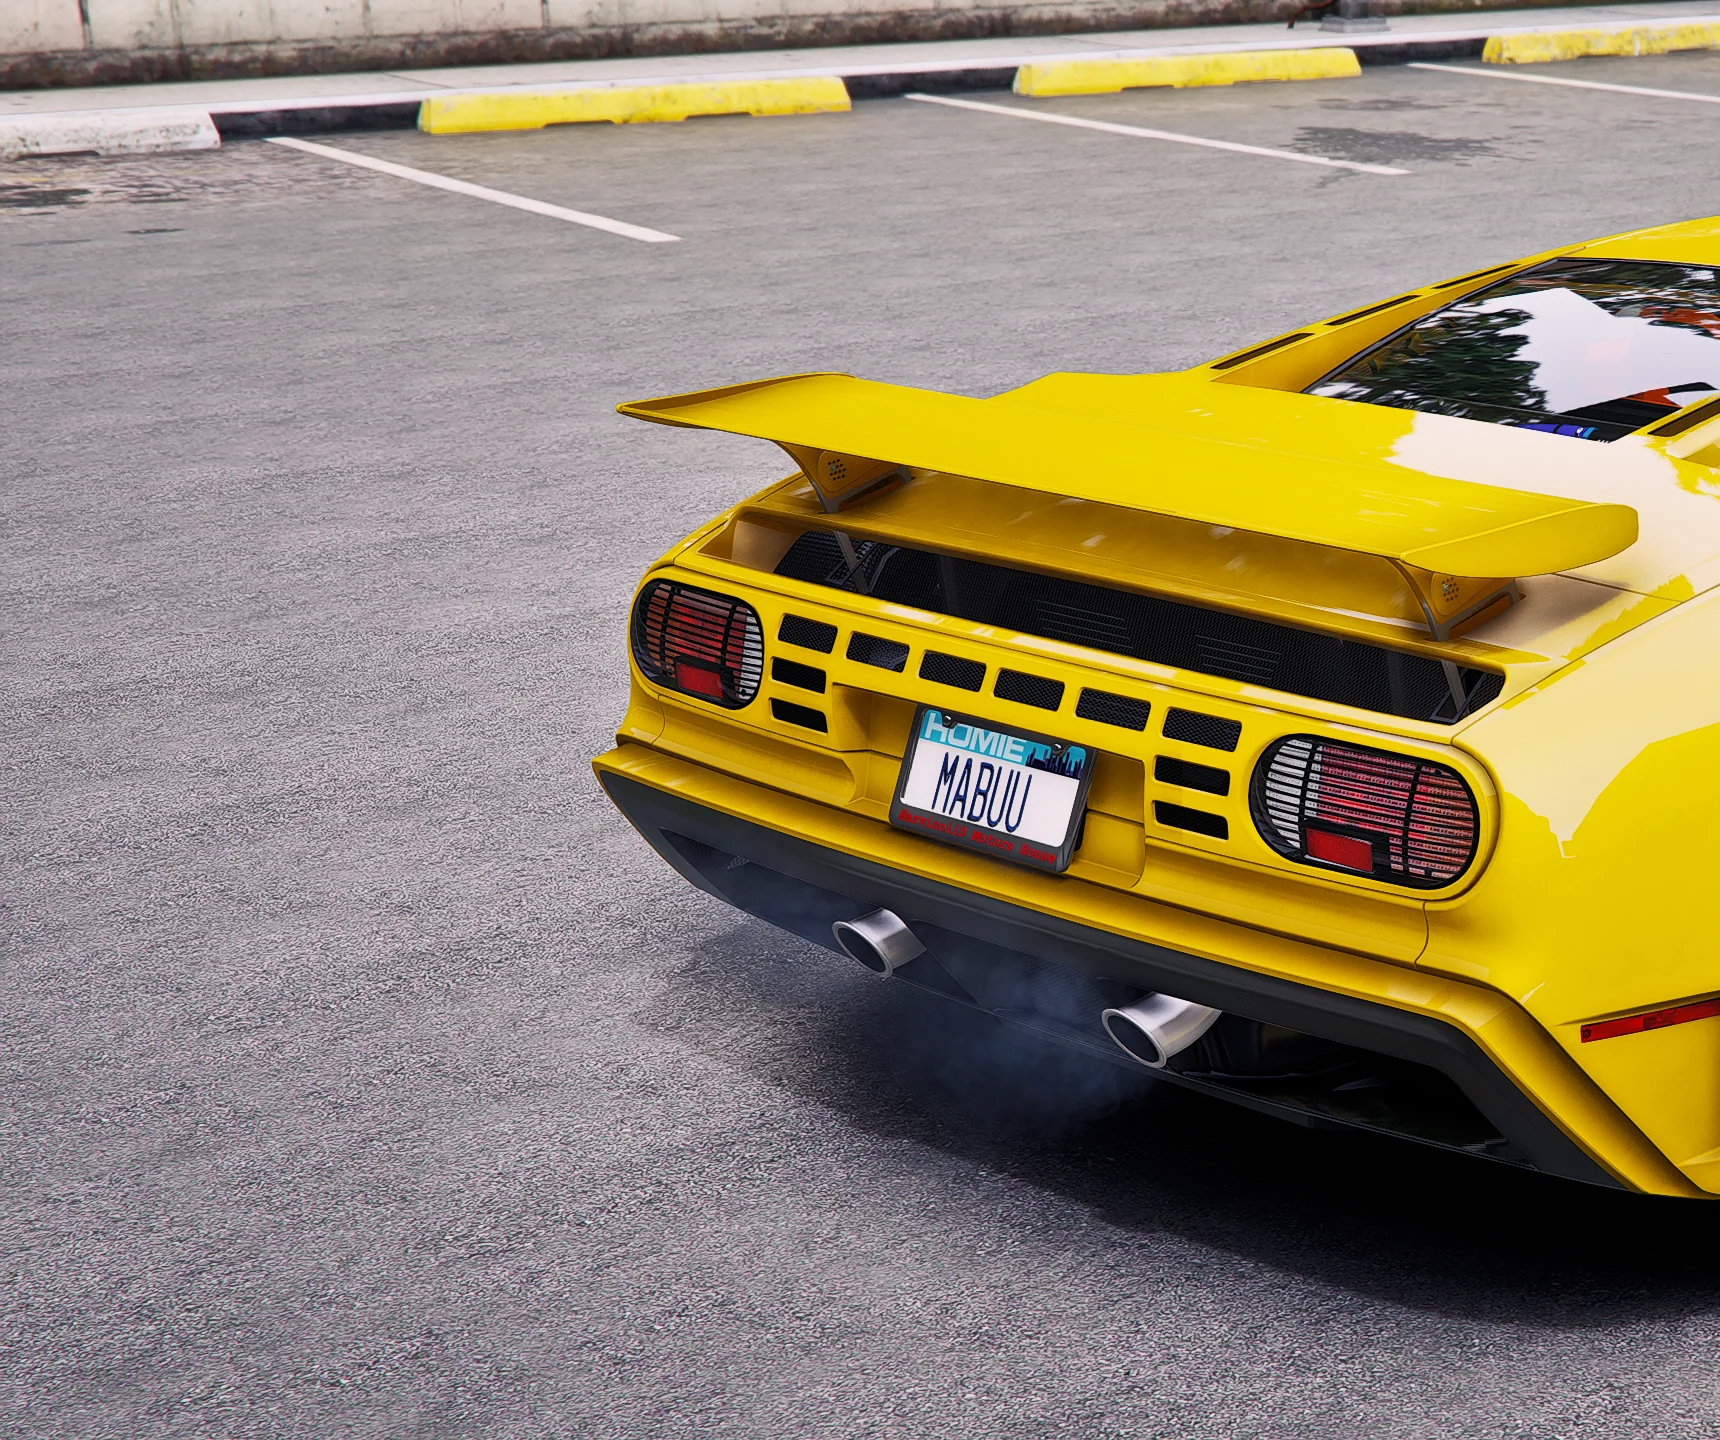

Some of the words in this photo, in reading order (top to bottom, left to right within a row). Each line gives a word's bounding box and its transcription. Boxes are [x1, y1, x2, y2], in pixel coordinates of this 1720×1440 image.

[924, 712, 1027, 763] HOMIE
[931, 751, 1033, 832] MABUU
[970, 829, 1015, 852] Motors
